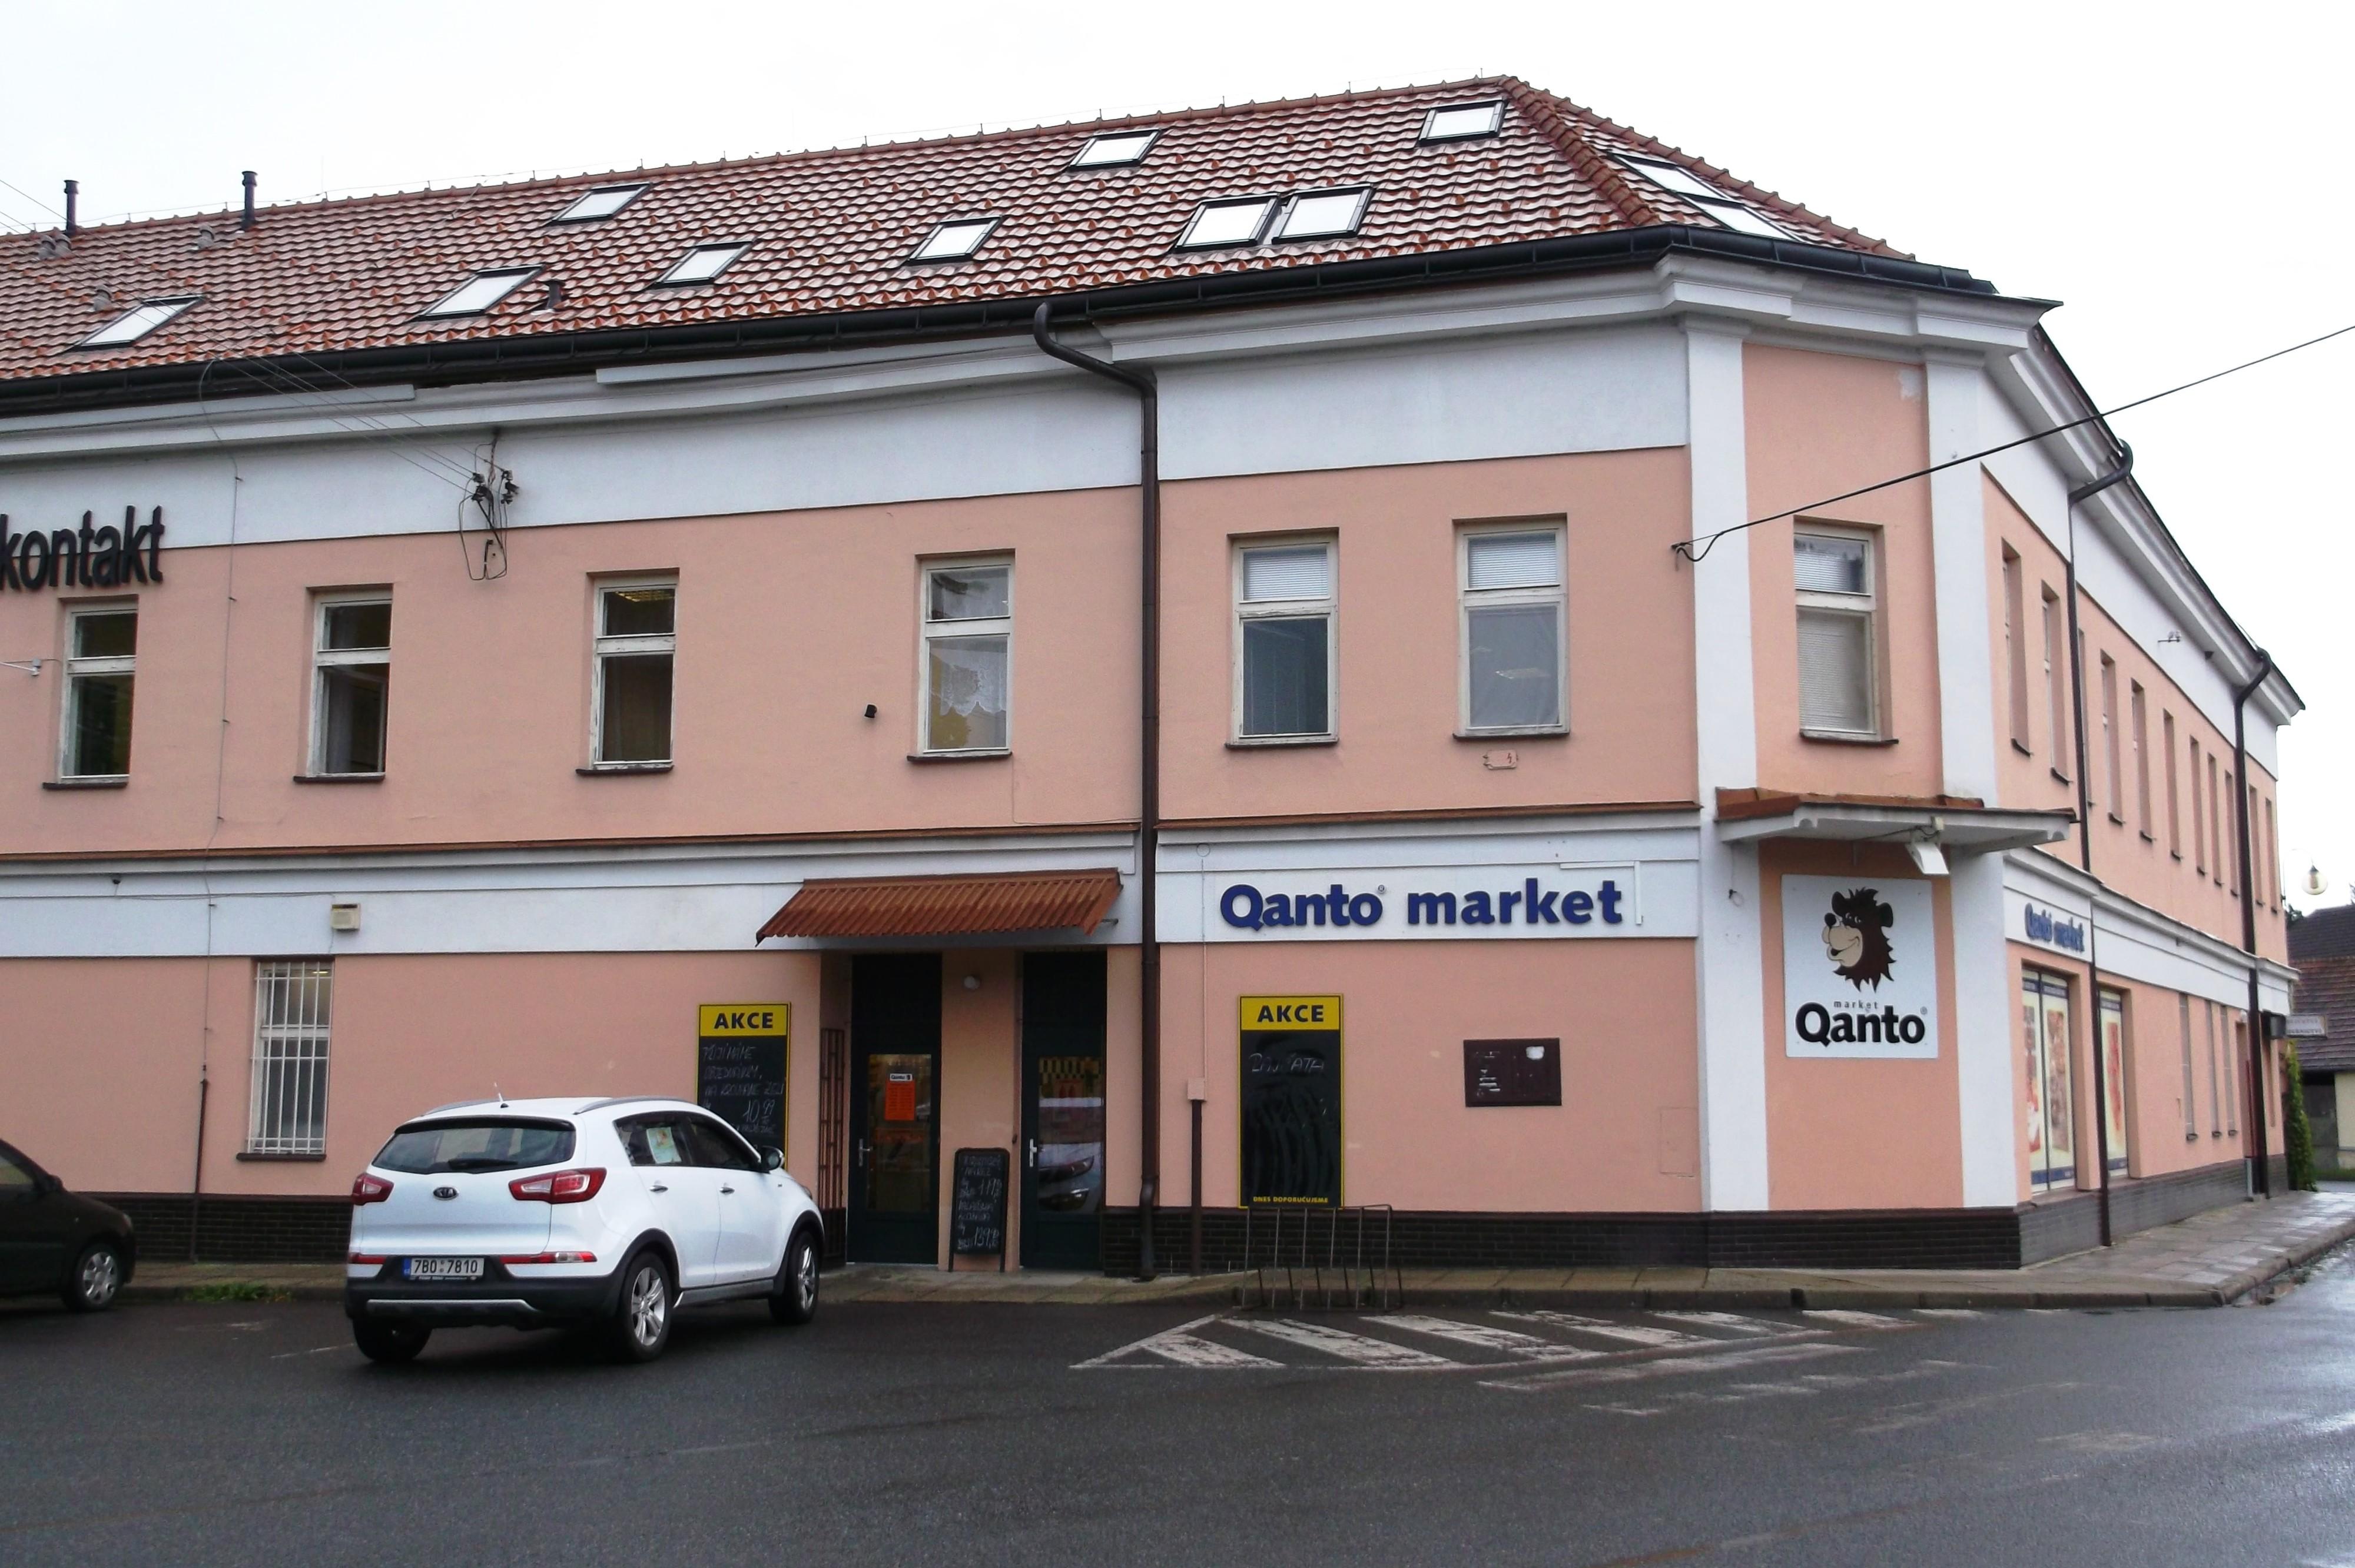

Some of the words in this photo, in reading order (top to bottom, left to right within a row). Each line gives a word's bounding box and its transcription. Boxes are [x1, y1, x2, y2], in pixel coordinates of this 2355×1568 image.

[0, 505, 165, 591] kontakt
[1220, 884, 1383, 931] Qanto
[1408, 878, 1623, 925] market
[1257, 1005, 1324, 1022] AKCE
[1833, 1001, 1879, 1009] market
[714, 1012, 774, 1029] AKCE
[1796, 1002, 1925, 1047] Qanto
[414, 1259, 437, 1273] 7B0
[447, 1259, 477, 1273] 7810
